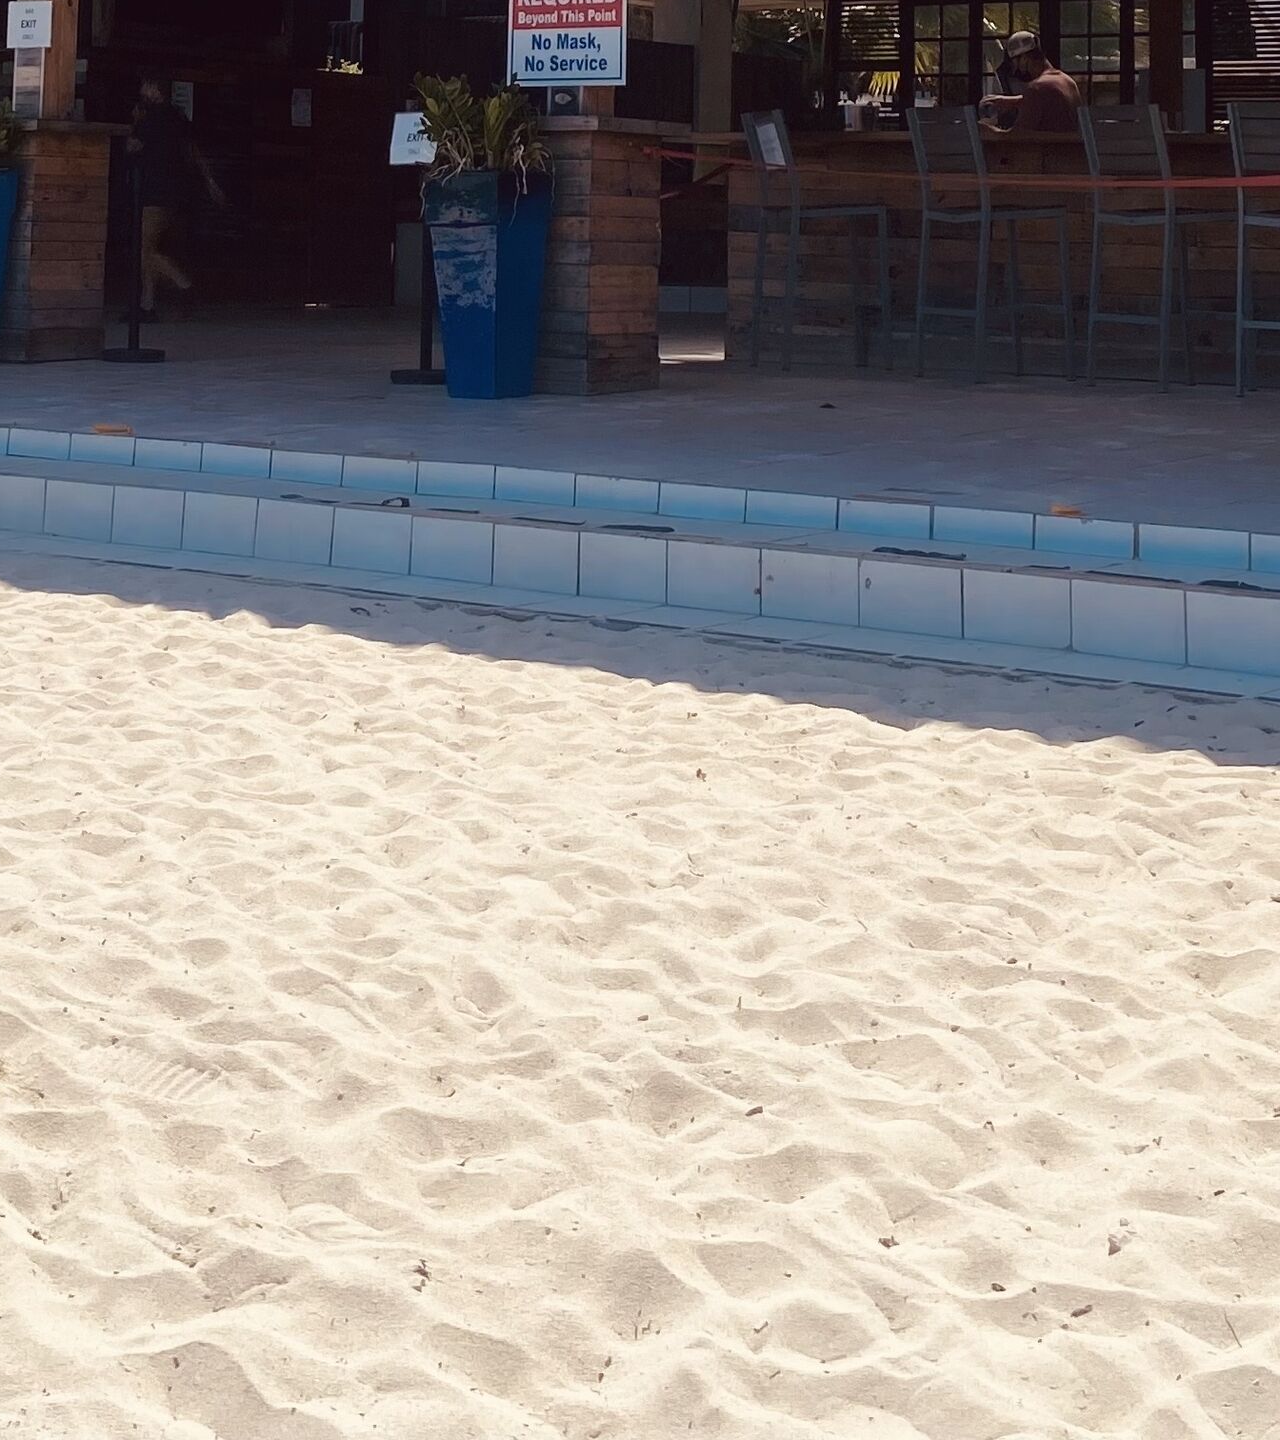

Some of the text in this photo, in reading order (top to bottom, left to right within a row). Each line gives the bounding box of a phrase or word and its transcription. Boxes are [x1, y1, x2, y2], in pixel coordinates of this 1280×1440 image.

[20, 19, 37, 28] EXIT
[518, 8, 616, 27] Beyond This Point
[531, 32, 601, 52] No Mask,
[524, 54, 608, 72] No Service
